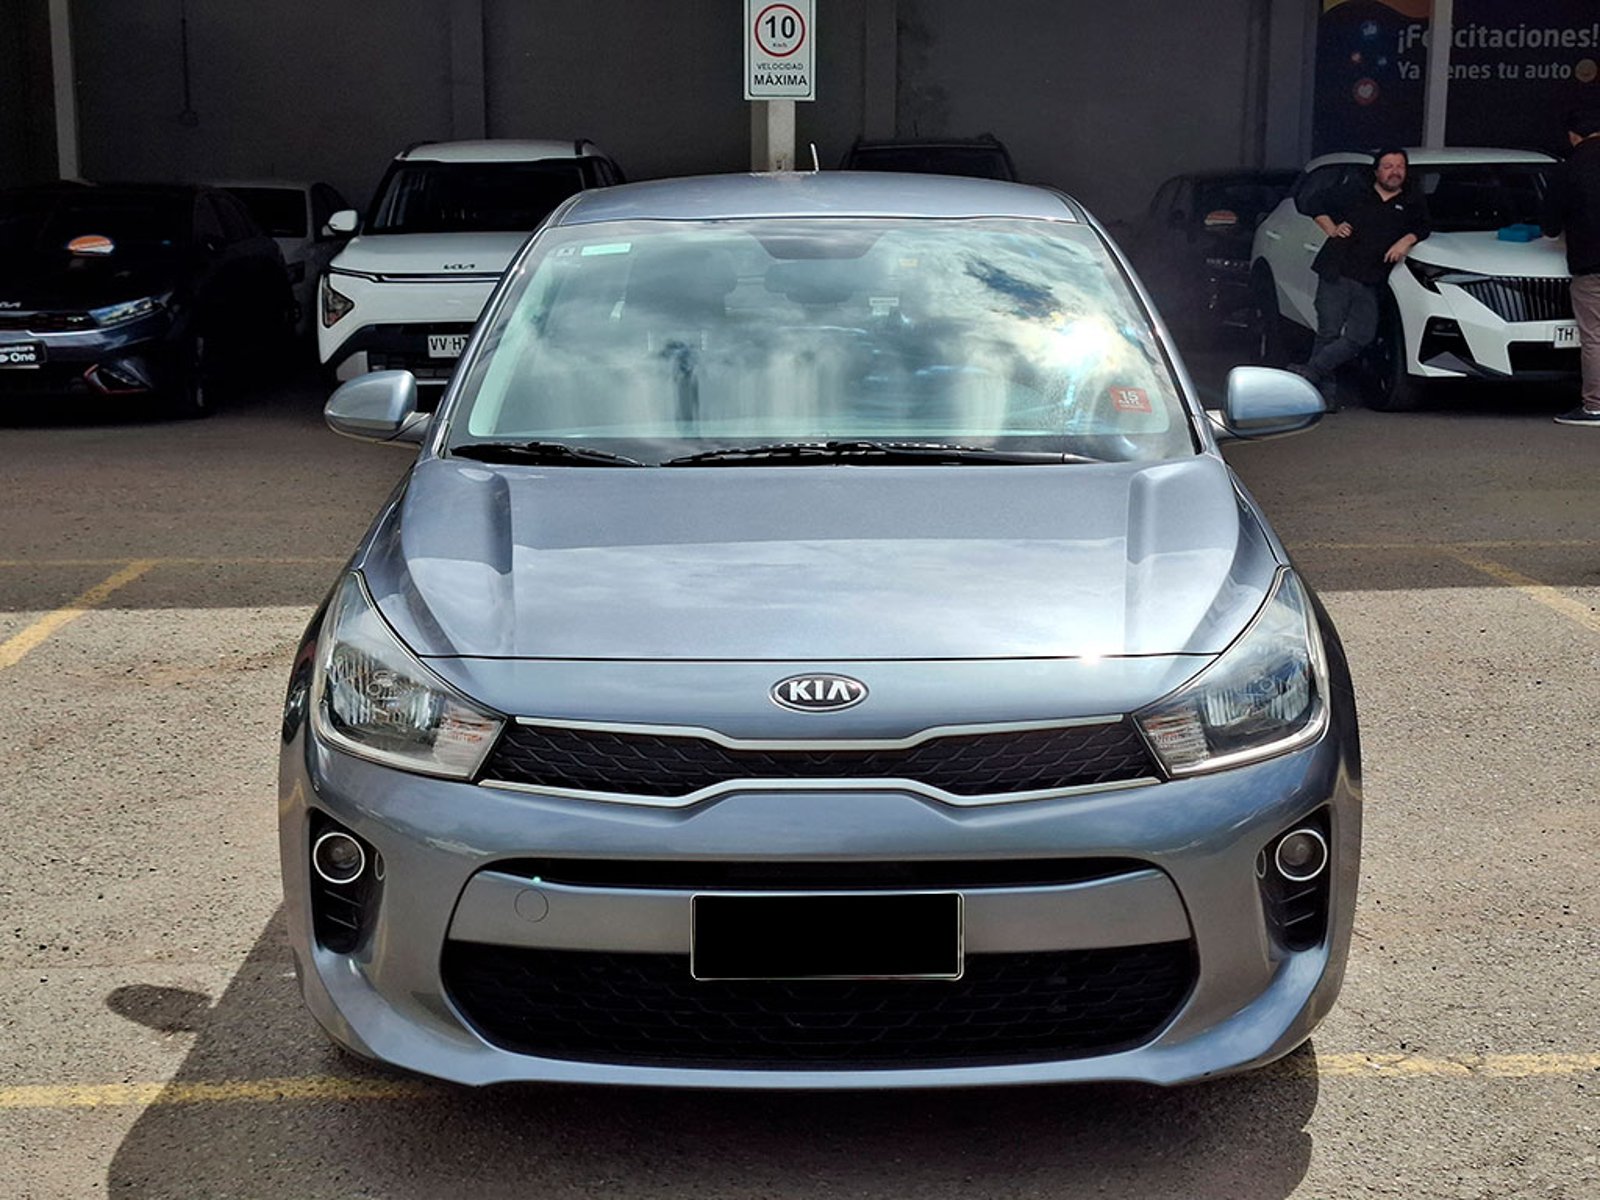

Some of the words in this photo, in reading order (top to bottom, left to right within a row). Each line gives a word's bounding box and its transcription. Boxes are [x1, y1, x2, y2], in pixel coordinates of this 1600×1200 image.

[765, 15, 796, 39] 10
[1397, 23, 1600, 54] ¡Fcitaciones!
[754, 73, 807, 85] MÁXIMA
[1397, 61, 1421, 80] Ya
[1448, 63, 1491, 80] enes
[1498, 61, 1519, 80] tu
[1524, 62, 1572, 80] auto
[10, 352, 36, 362] One
[788, 680, 851, 701] KIA
